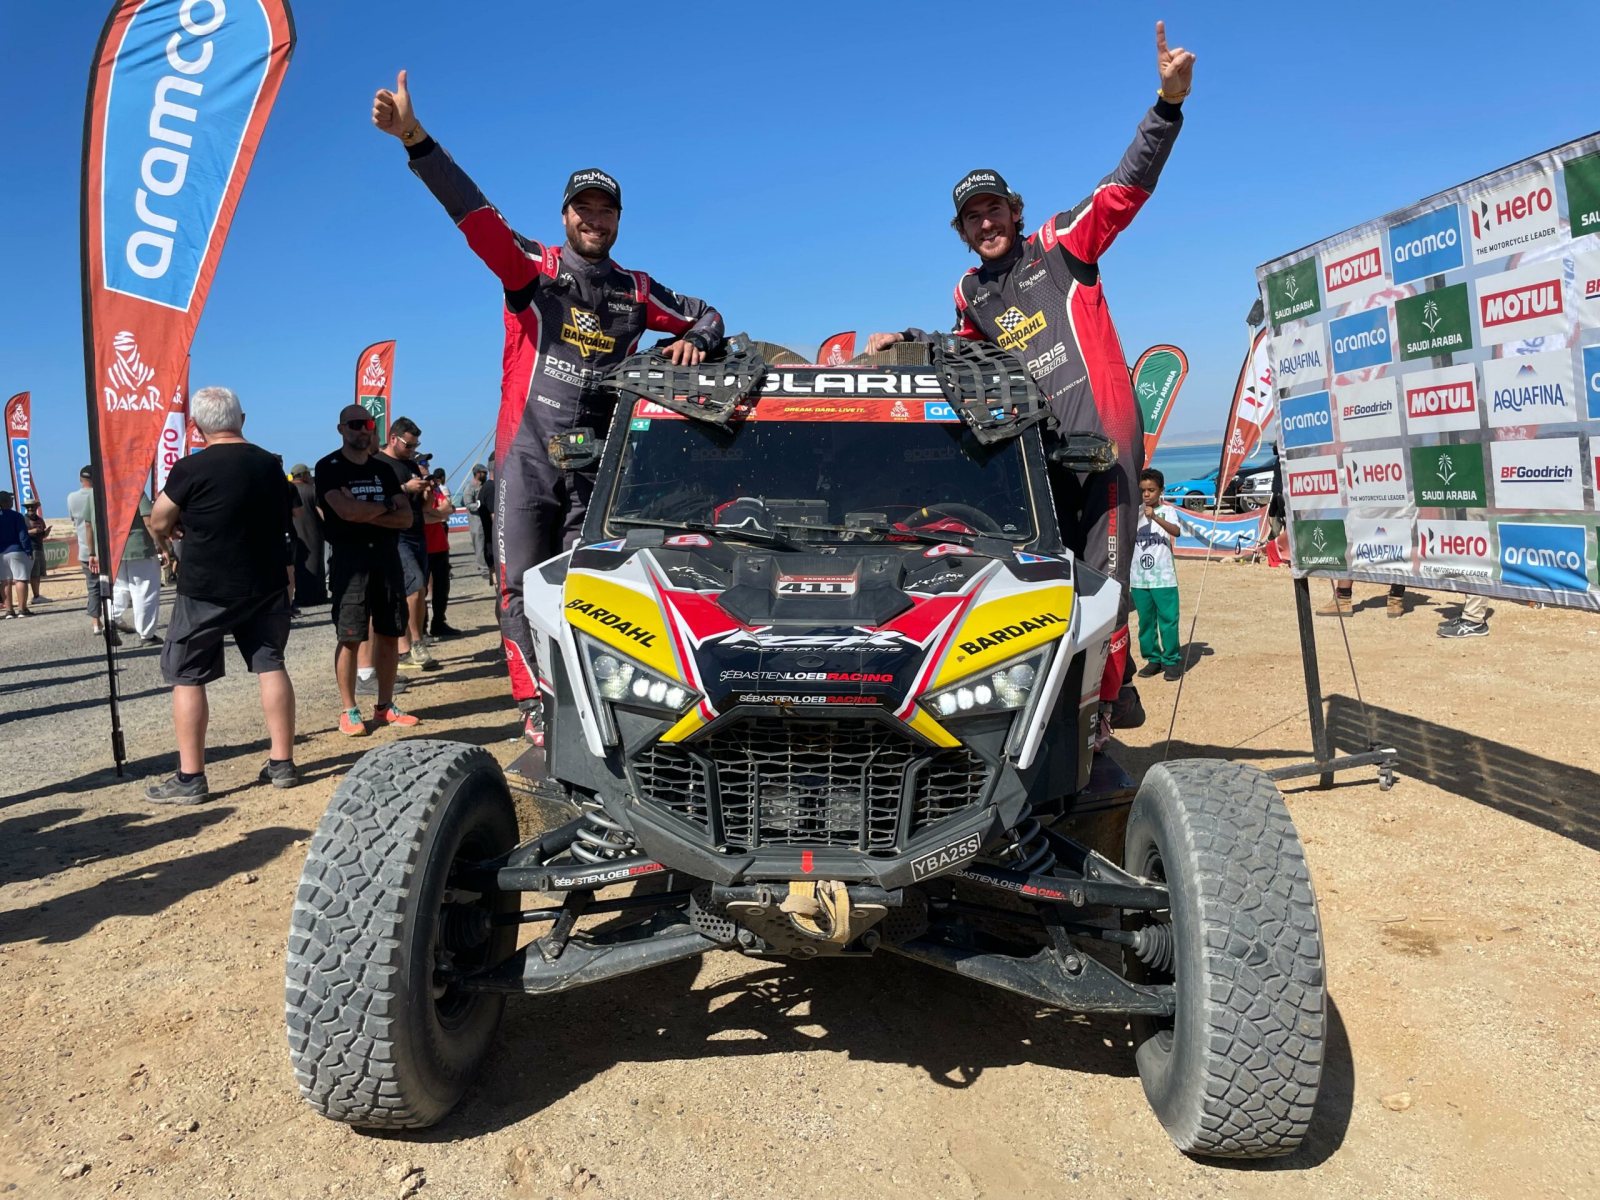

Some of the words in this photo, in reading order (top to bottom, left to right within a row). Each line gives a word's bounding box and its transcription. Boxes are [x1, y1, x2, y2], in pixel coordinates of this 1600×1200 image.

[126, 0, 226, 279] aramco
[1394, 228, 1457, 264] aramco
[1476, 247, 1489, 256] THE
[1489, 234, 1530, 252] MOTORCYCLE
[1530, 227, 1556, 241] LEADER
[1328, 252, 1379, 288] MOTUL
[1274, 308, 1292, 320] SAUDI
[1292, 299, 1314, 315] ARABIA
[1485, 286, 1559, 322] MOTUL
[562, 328, 611, 350] BARDAHL
[999, 318, 1044, 348] BARDAHL
[1334, 327, 1387, 354] aramco
[1407, 339, 1429, 353] SAUDI
[1430, 333, 1463, 349] ARABIA
[1279, 350, 1321, 376] AQUAFINA
[363, 375, 387, 387] DAKAR
[104, 387, 164, 412] DAKAR
[1151, 395, 1168, 420] SAUDI
[1161, 370, 1177, 398] ARABIA
[1411, 387, 1471, 414] MOTUL
[1493, 383, 1565, 413] AQUAFINA
[1284, 411, 1329, 431] aramco
[1343, 400, 1393, 417] BFGoodrich
[1292, 473, 1336, 494] MOTUL
[1363, 463, 1402, 482] Hero
[1500, 466, 1573, 478] BFGoodrich
[1422, 491, 1445, 501] SAUDI
[1446, 491, 1478, 501] ARABIA
[1356, 543, 1405, 563] AQUAFINA
[1440, 535, 1487, 557] Hero
[1504, 547, 1581, 570] aramco
[780, 583, 847, 593] 411
[565, 599, 656, 649] BARDAHL
[960, 612, 1067, 655] BARDAHL
[915, 838, 979, 875] YBA25S
